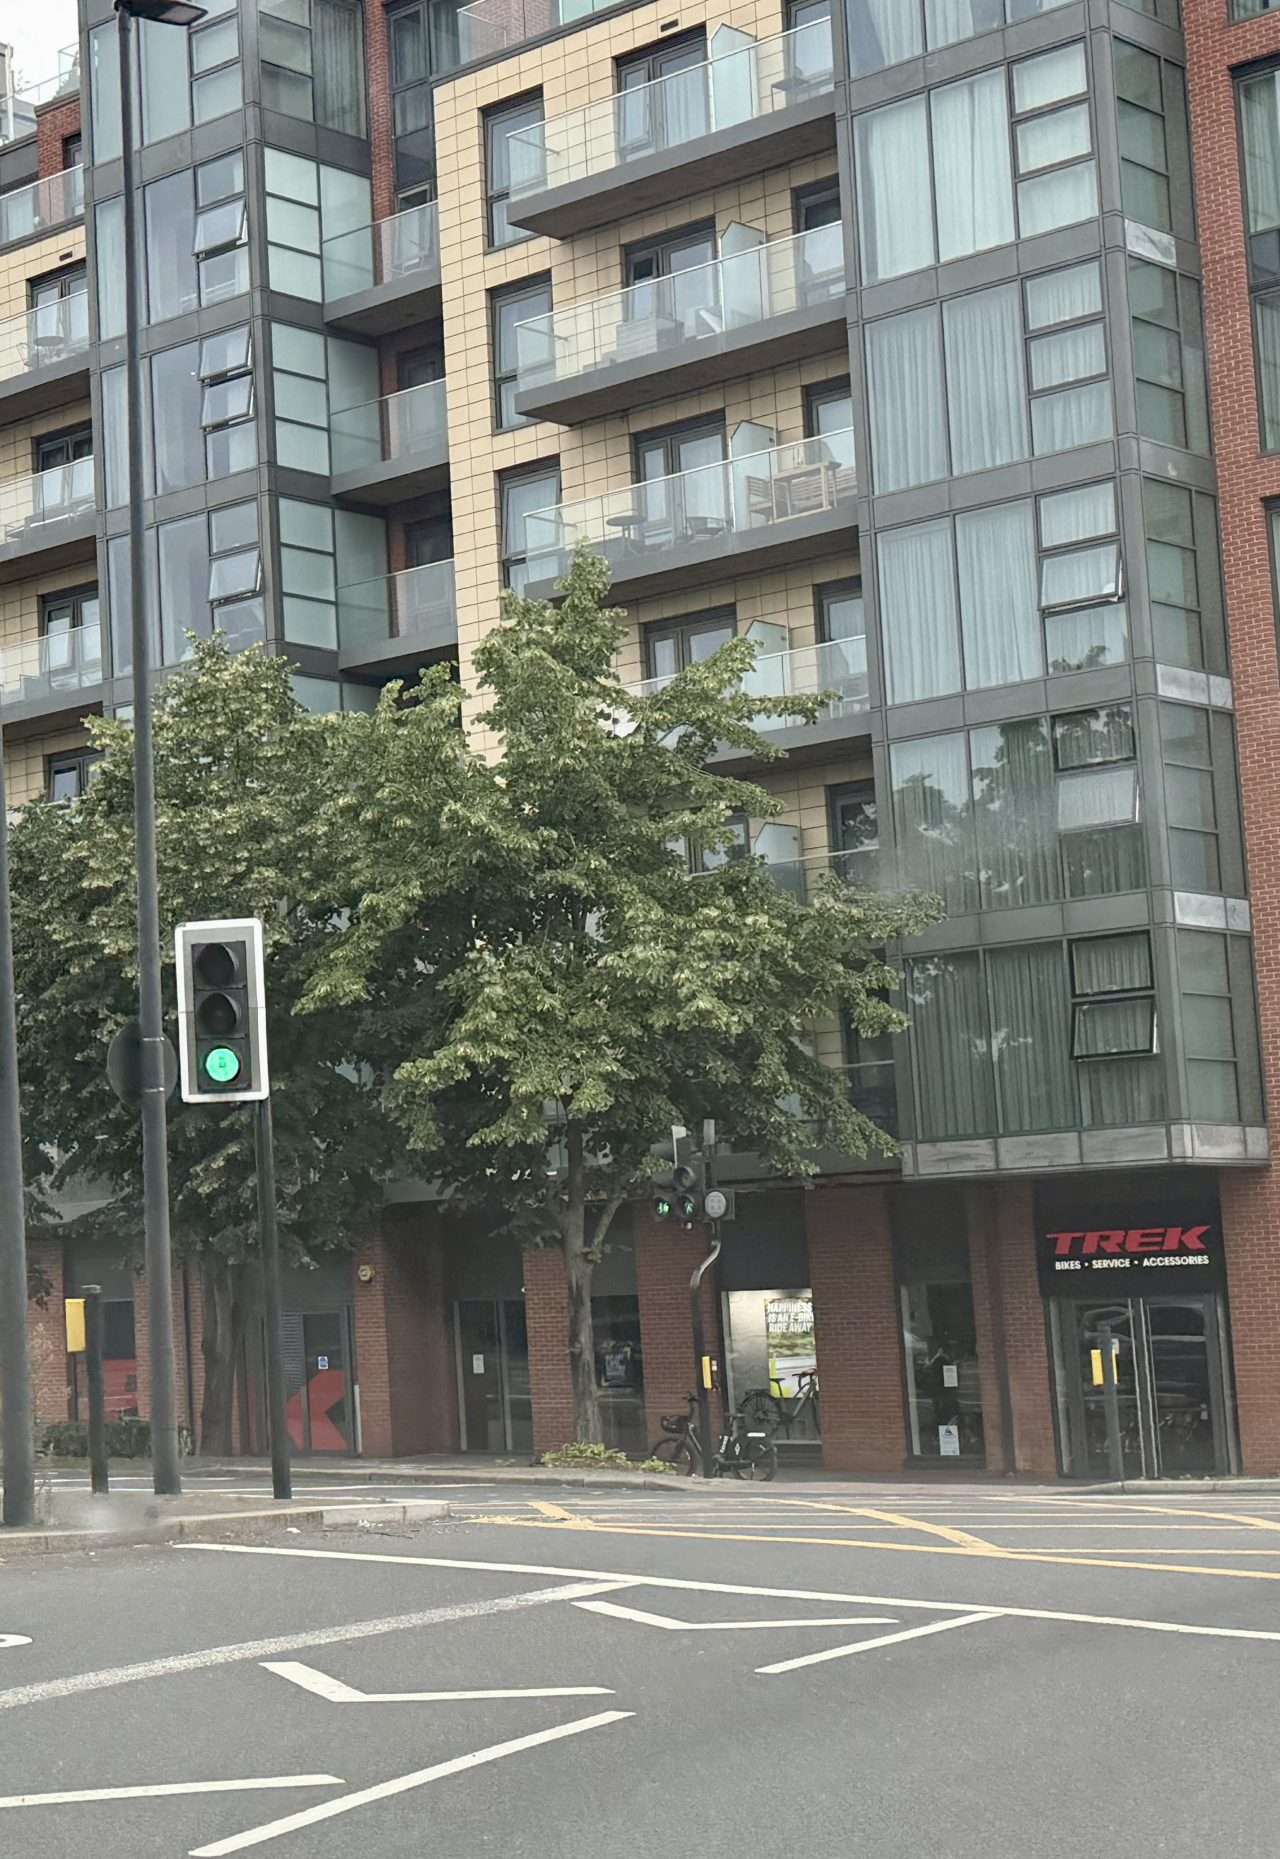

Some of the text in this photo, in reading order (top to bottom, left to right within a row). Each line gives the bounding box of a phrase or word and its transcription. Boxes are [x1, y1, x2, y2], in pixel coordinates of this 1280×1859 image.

[1045, 1224, 1212, 1256] TREK
[1055, 1255, 1210, 1271] BIKES SERVICE ACCESSORIES
